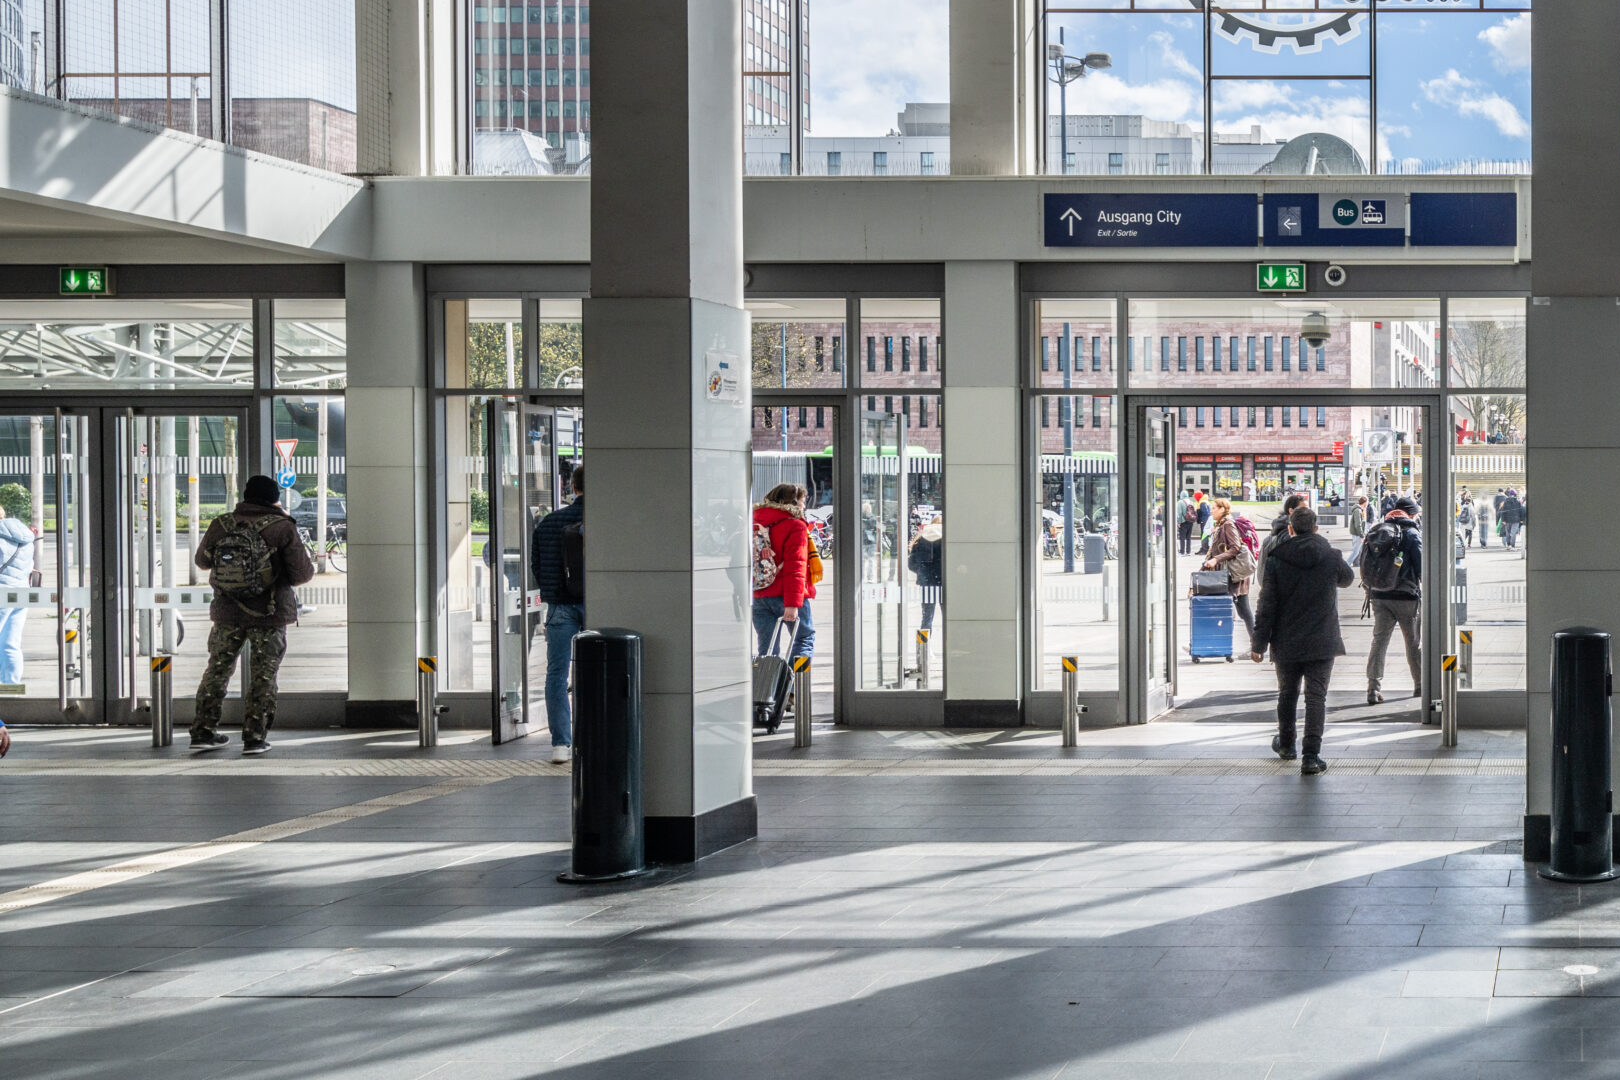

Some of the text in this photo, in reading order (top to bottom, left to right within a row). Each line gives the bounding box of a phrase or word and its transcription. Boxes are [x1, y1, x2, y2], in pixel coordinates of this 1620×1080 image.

[1337, 207, 1355, 217] Bus
[1097, 210, 1182, 226] Ausgang City
[1097, 229, 1112, 237] Exit
[1116, 229, 1138, 237] Sortie
